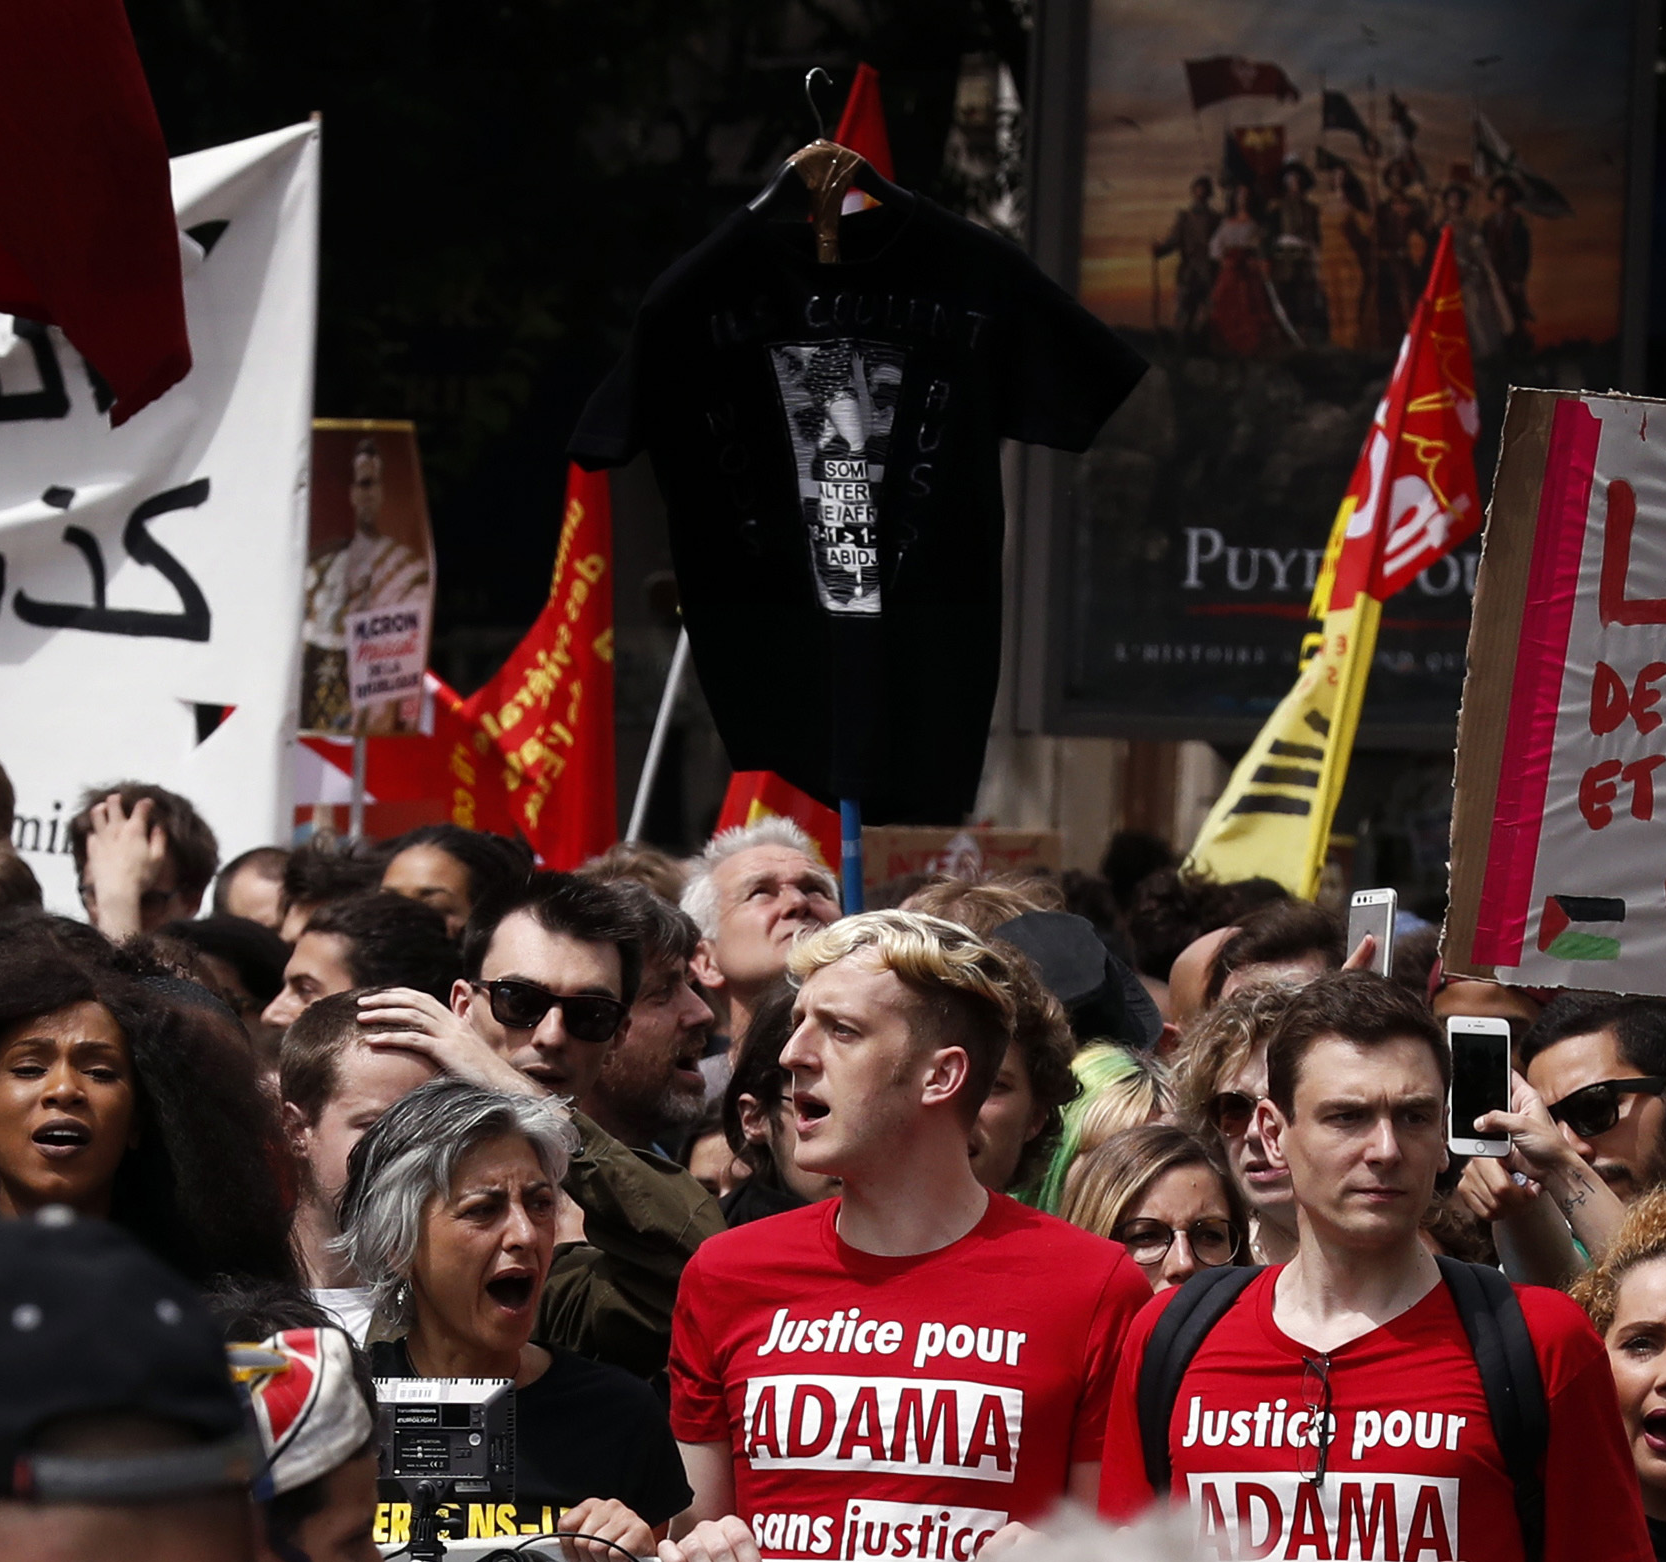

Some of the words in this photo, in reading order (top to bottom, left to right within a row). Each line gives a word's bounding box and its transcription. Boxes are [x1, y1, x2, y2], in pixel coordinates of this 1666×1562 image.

[1578, 755, 1666, 830] ET
[757, 1307, 903, 1357] Justice
[913, 1320, 1027, 1368] pour
[749, 1383, 1012, 1472] ADAMA
[1181, 1395, 1337, 1449] Justice
[1351, 1408, 1467, 1461] pour
[752, 1510, 835, 1554] sans
[1197, 1481, 1455, 1562] ADAMA
